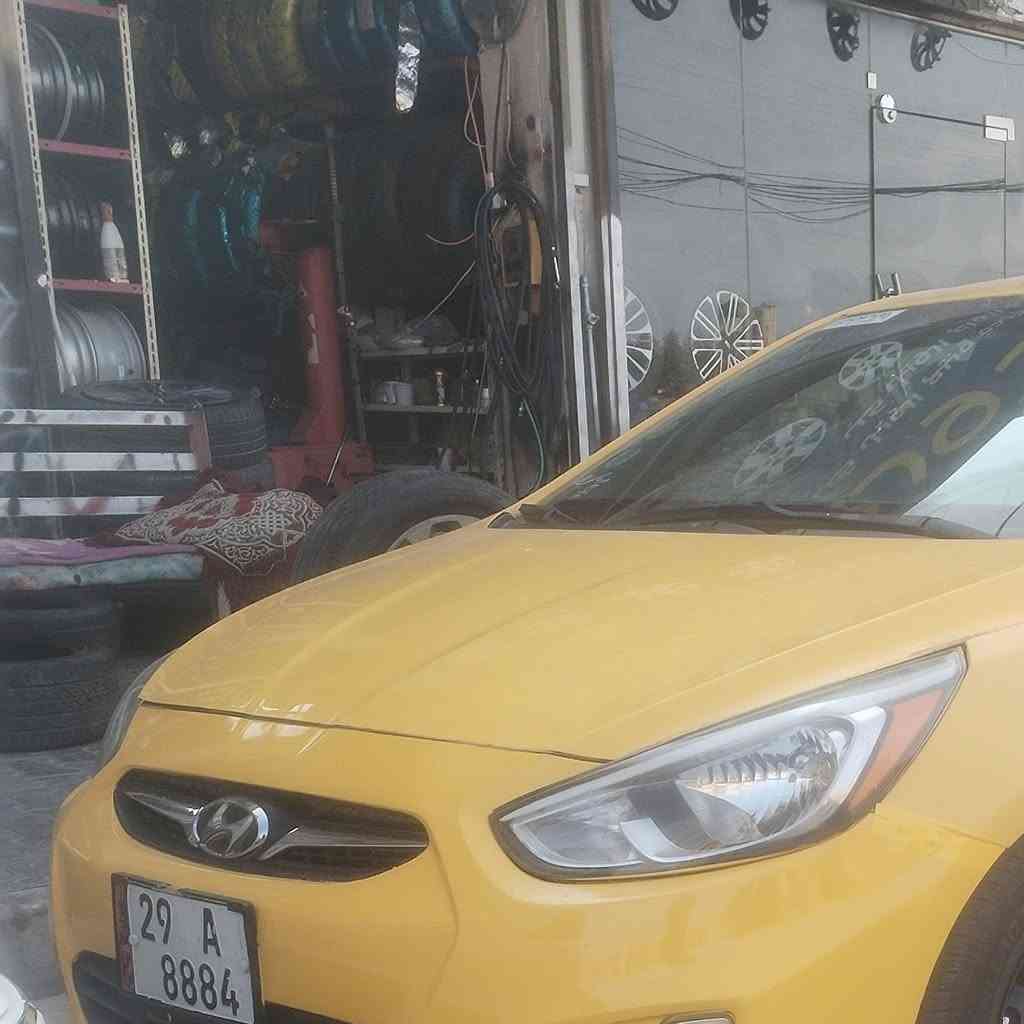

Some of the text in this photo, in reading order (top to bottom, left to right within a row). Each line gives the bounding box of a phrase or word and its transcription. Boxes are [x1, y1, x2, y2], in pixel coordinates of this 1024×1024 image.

[138, 893, 221, 957] 29 A
[161, 954, 240, 1016] 8884
